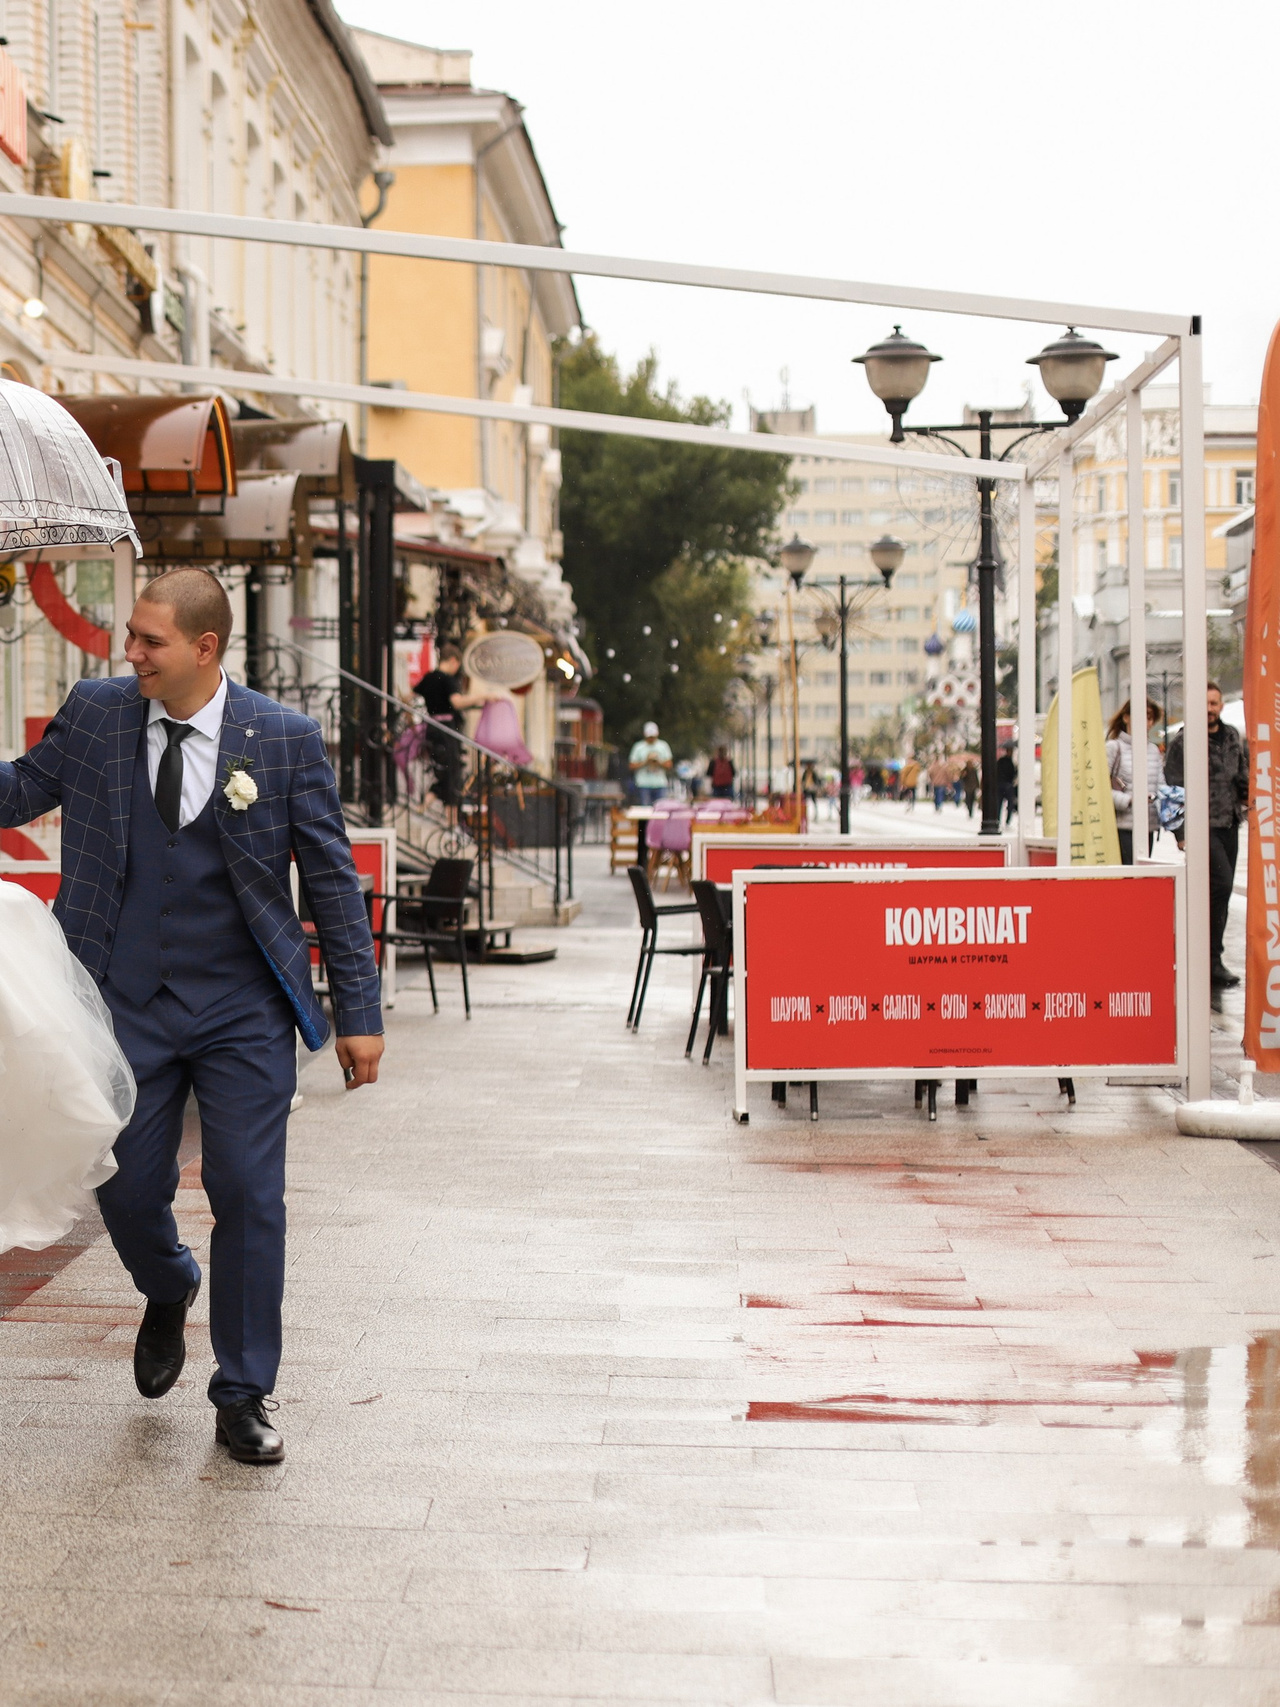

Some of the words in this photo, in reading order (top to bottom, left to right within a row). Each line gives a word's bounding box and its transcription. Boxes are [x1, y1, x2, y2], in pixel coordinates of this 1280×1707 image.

[884, 906, 1032, 946] KOMBINAT
[908, 955, 948, 965] ШАУРМА
[951, 955, 958, 964] И
[960, 954, 1009, 964] СТРИТФУД
[770, 996, 812, 1023] ШАУРМА
[827, 995, 867, 1025] ДОНЕРЫ
[882, 994, 921, 1020] САЛАТЫ
[940, 993, 968, 1020] СУПЫ
[984, 993, 1027, 1020] ЗАКУСКИ
[1043, 992, 1087, 1022] ДЕСЕРТЫ
[1108, 991, 1152, 1018] НАПИТКИ
[929, 1047, 993, 1055] KOMBINATFOOD.RU
